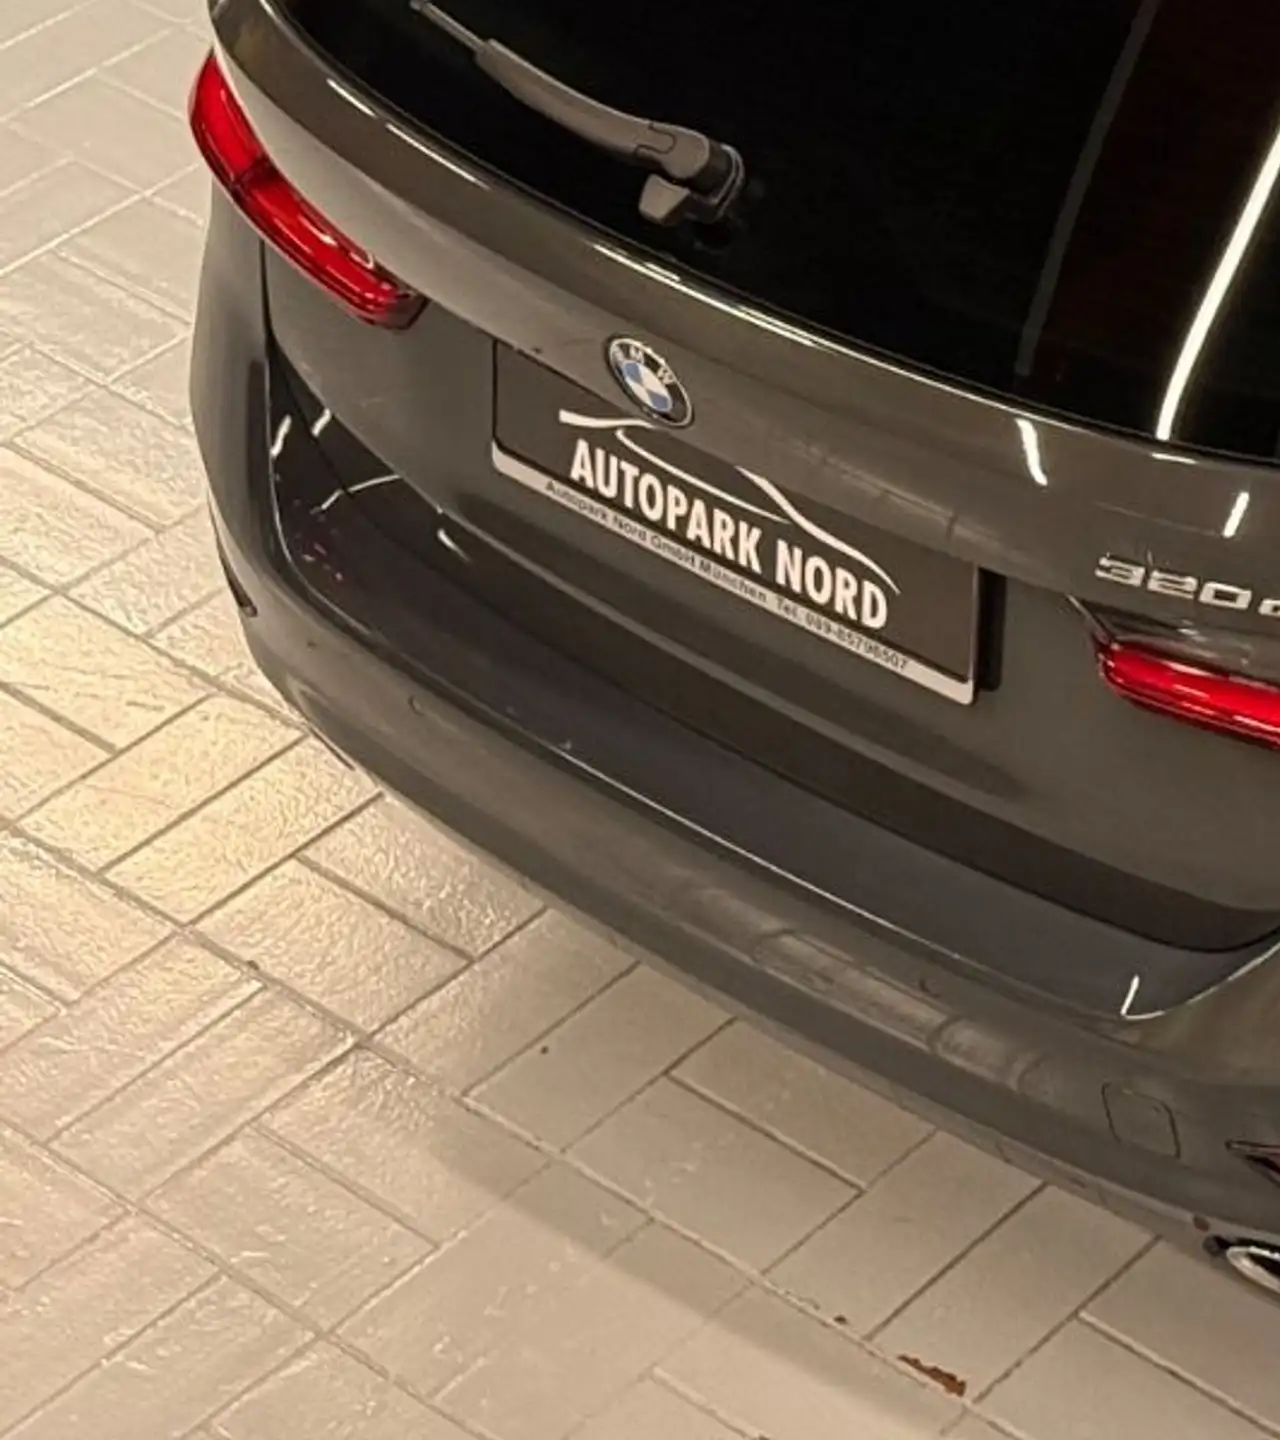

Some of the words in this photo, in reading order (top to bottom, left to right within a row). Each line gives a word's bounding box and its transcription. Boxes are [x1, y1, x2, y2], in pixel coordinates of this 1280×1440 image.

[570, 438, 763, 574] AUTOPARK
[775, 539, 888, 630] NORD
[613, 514, 648, 542] Nord
